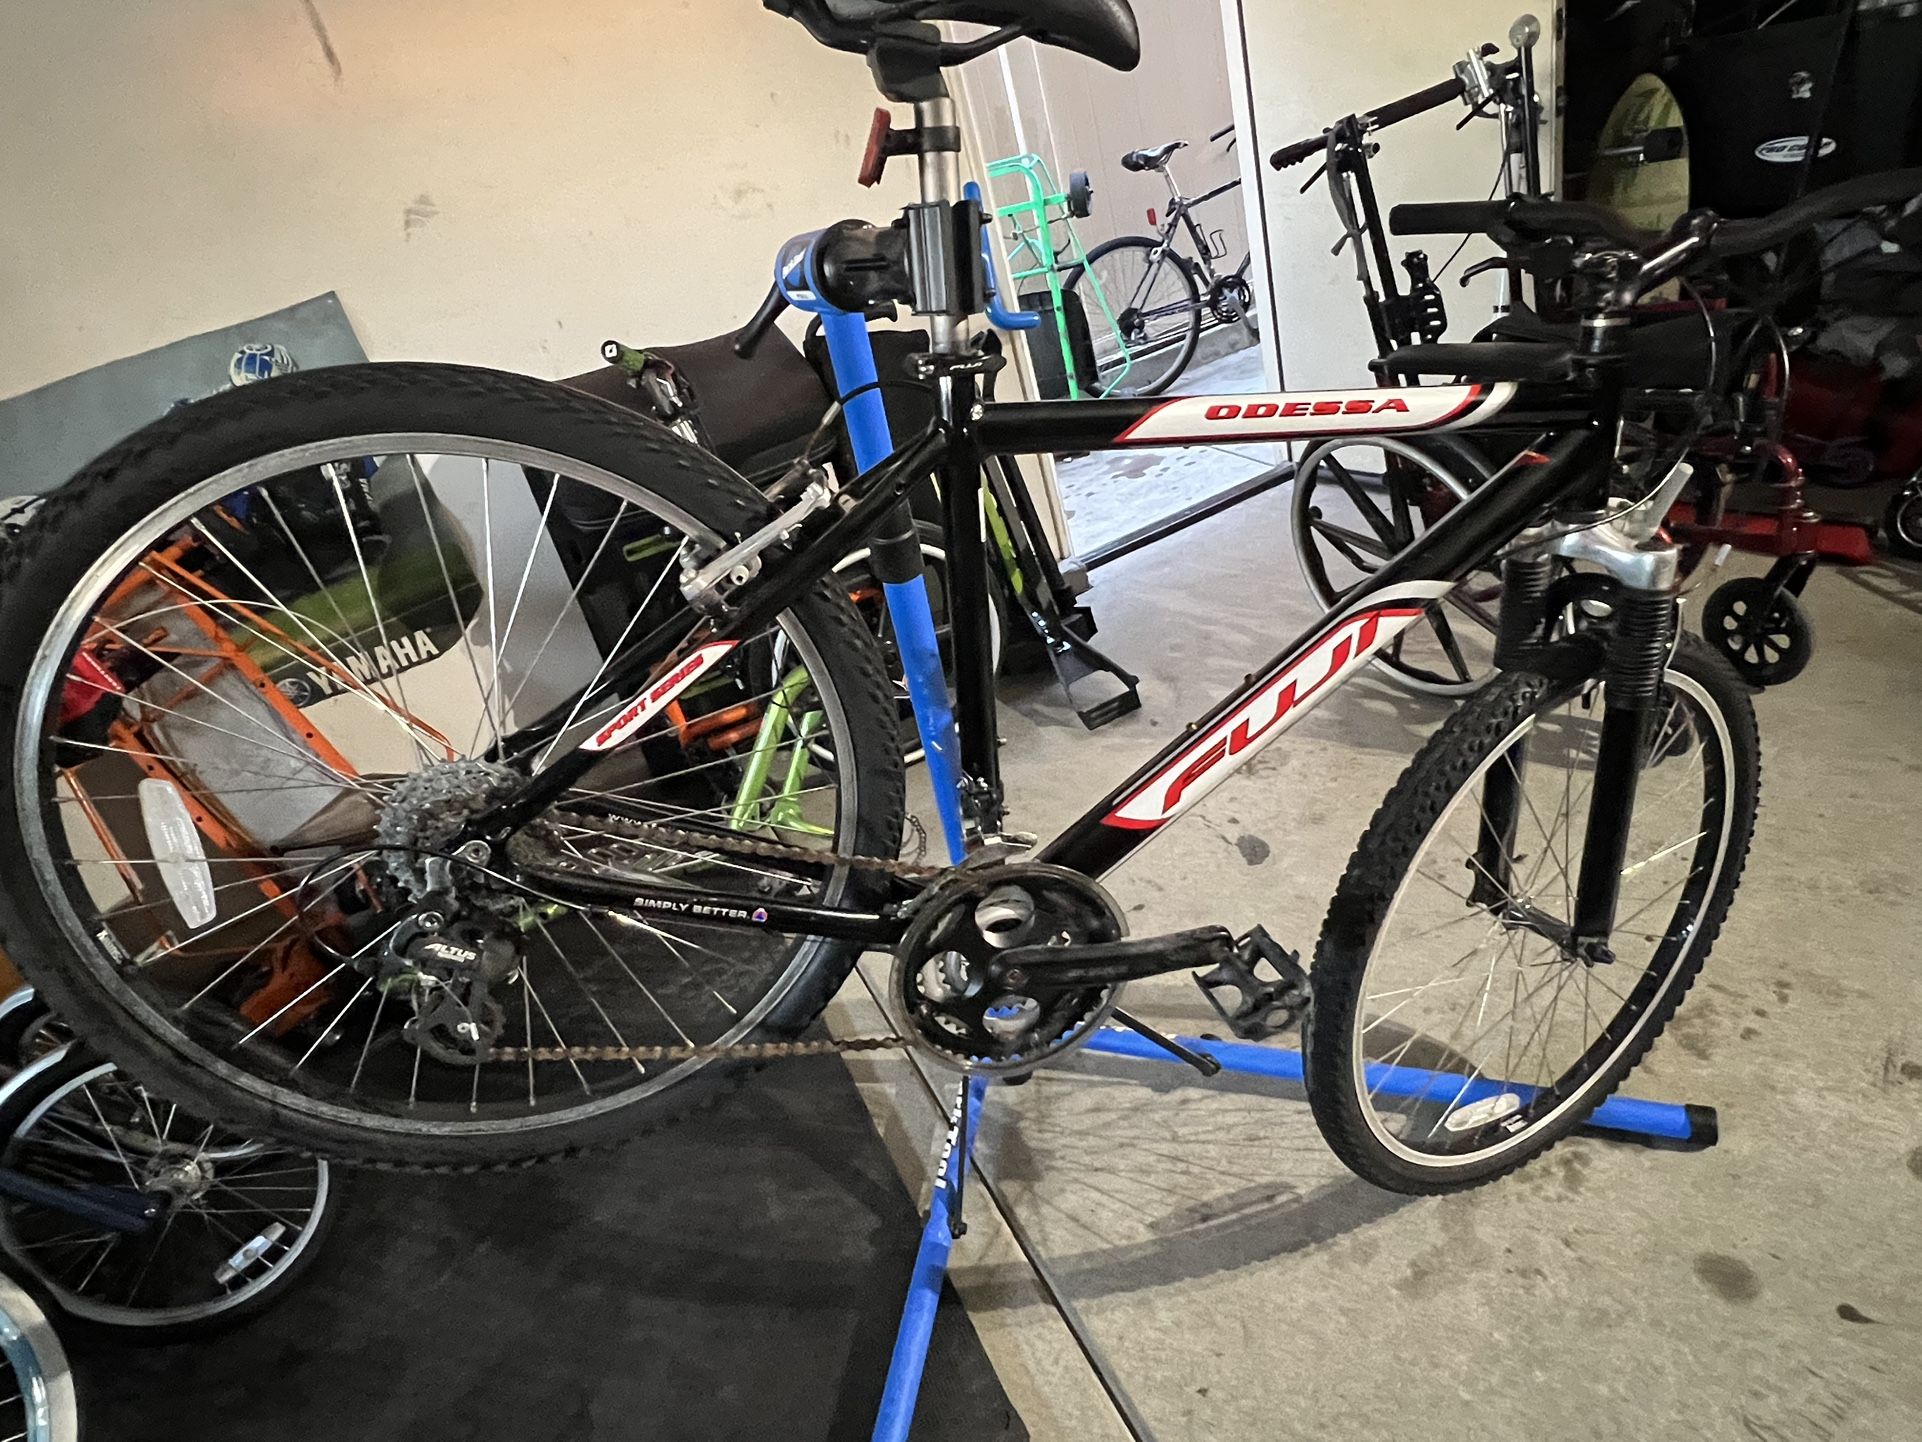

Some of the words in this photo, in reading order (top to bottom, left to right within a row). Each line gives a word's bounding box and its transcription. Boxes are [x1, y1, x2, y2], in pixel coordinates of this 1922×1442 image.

[1204, 398, 1410, 420] ODESSA
[596, 697, 647, 747] SPORT
[1161, 611, 1381, 815] FUJI
[633, 897, 689, 912] SIMPLY
[424, 943, 477, 960] ALTUS
